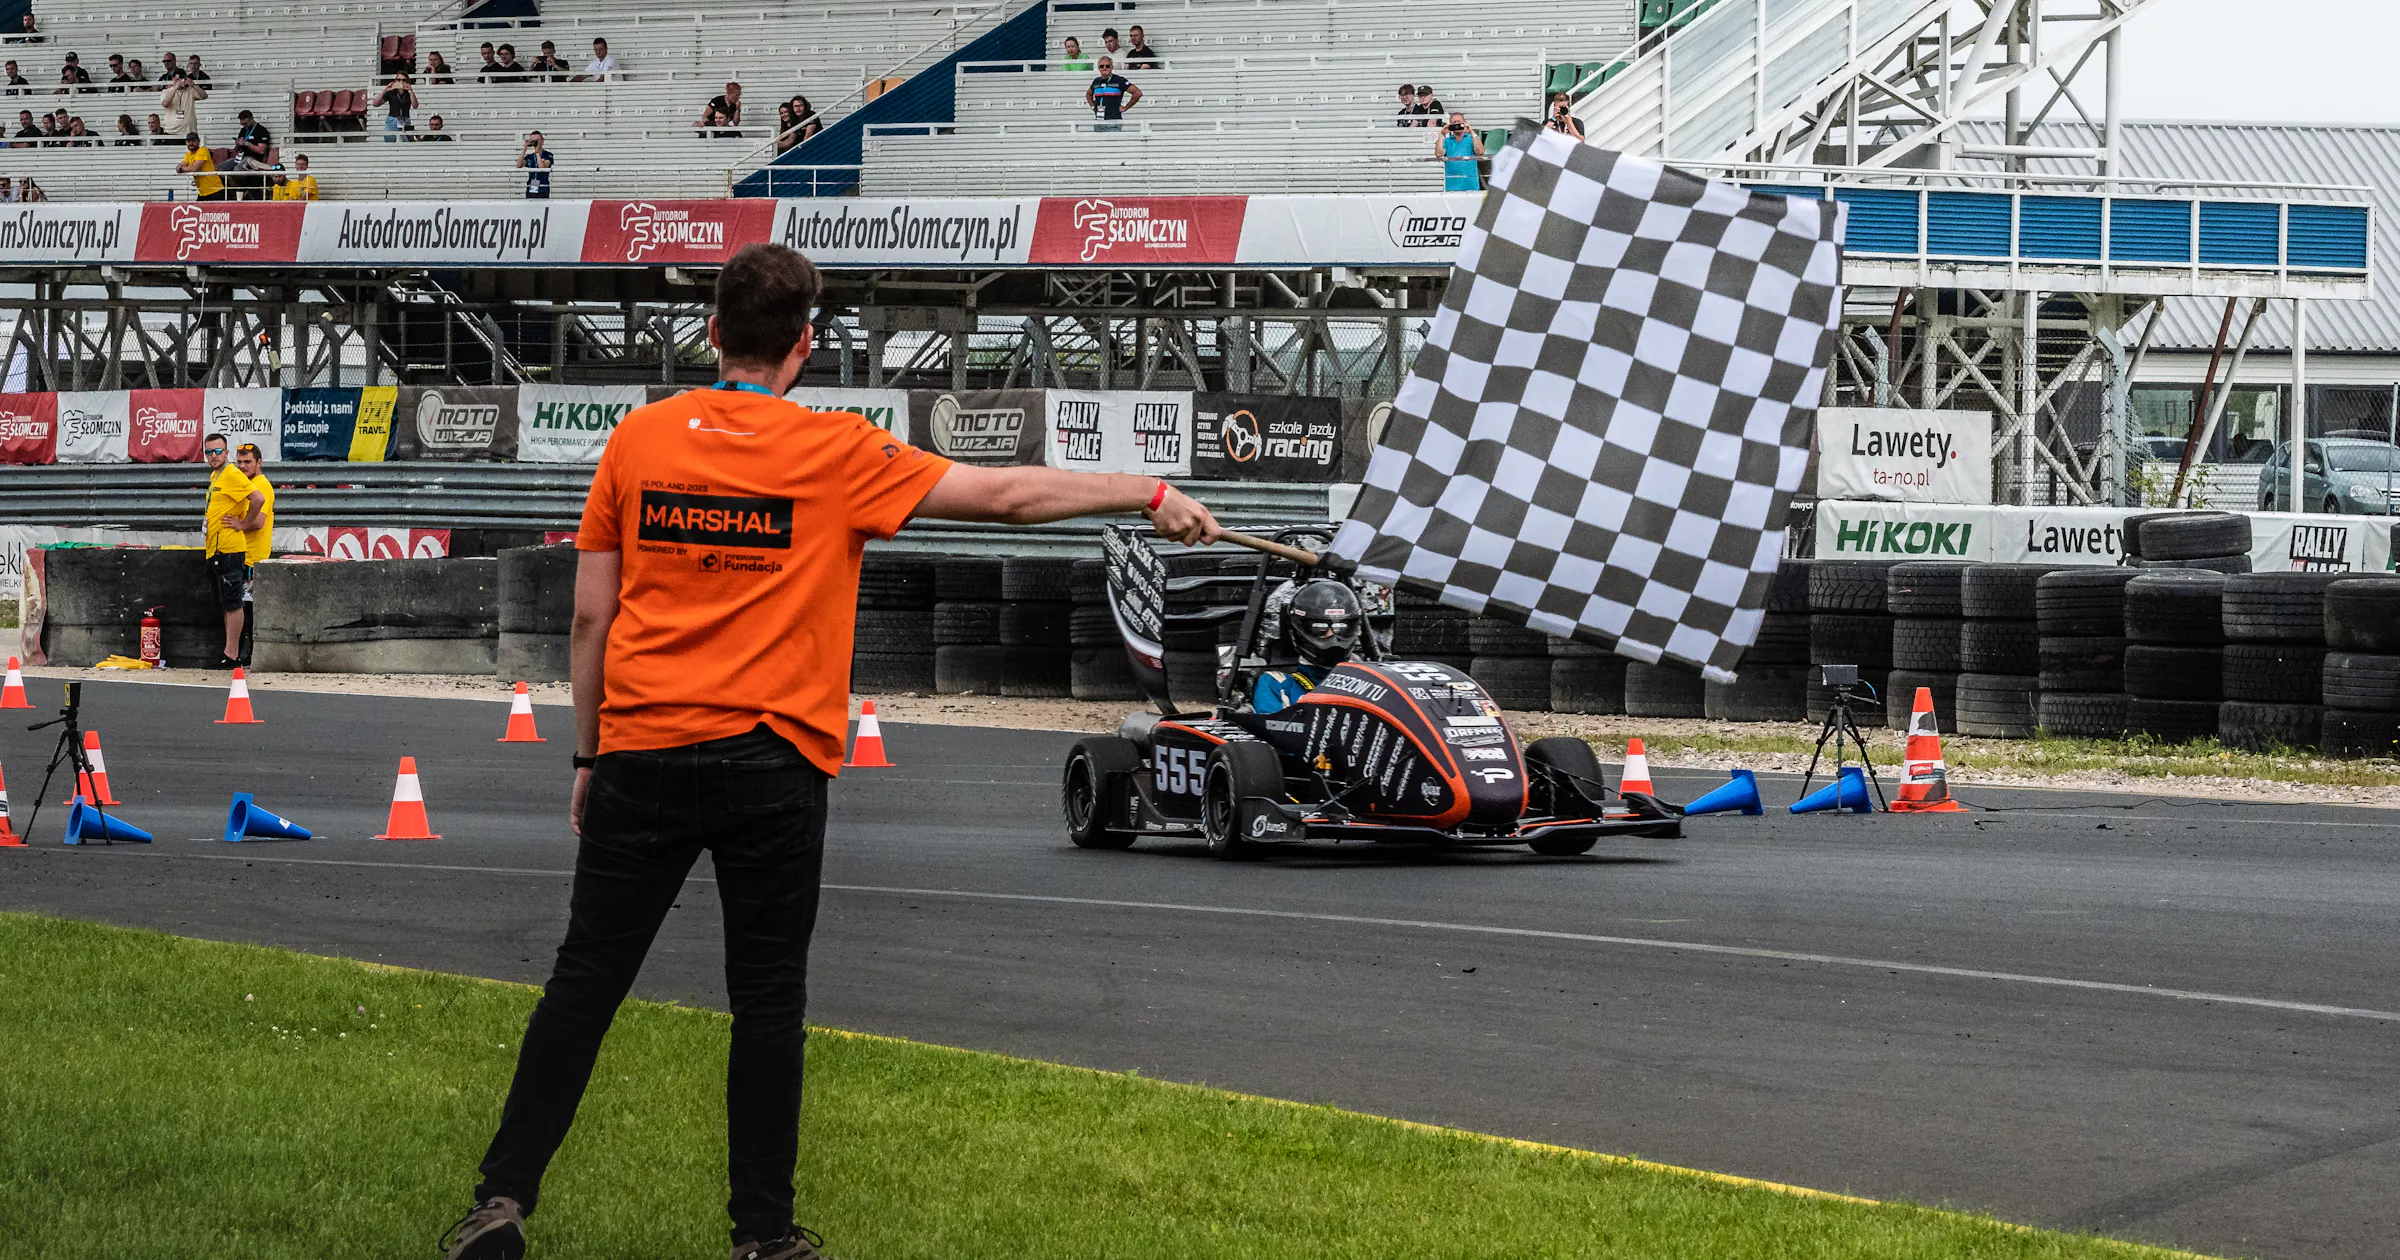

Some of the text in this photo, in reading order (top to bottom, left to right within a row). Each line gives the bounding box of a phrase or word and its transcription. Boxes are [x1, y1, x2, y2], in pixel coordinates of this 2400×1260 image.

[199, 213, 230, 223] AUTODROM
[653, 211, 689, 221] AUTODROM
[1110, 208, 1150, 219] AUTODROM
[338, 206, 549, 259] AutodromSlomczyn.pl
[652, 221, 723, 244] SŁOMCZYN
[784, 205, 1021, 260] AutodromSlomczyn.pl
[1108, 219, 1187, 244] SŁOMCZYN
[1406, 216, 1467, 232] MOTO
[198, 223, 260, 245] SŁOMCZYN
[1403, 235, 1462, 247] WIZJA
[285, 400, 323, 417] Podróżuj
[324, 404, 329, 414] z
[330, 401, 353, 414] nami
[436, 407, 498, 426] MOTO
[1059, 402, 1099, 429] RALLY
[155, 419, 198, 434] SŁOMCZYN
[231, 418, 272, 432] SŁOMCZYN
[954, 412, 1023, 432] MOTO
[1137, 405, 1178, 431] RALLY
[9, 422, 48, 436] SŁOMCZYN
[81, 421, 122, 435] SŁOMCZYN
[284, 420, 330, 436] po Europie
[358, 426, 387, 434] TRAVEL
[434, 429, 492, 442] WIZJA
[1269, 422, 1337, 438] szkoła jazdy
[530, 436, 546, 445] HIGH
[547, 437, 587, 446] PERFORMANCE
[952, 438, 1015, 450] WIZJA
[1067, 434, 1100, 460] RACE
[1145, 435, 1178, 461] RACE
[1851, 423, 1957, 468] Lawety.
[1265, 436, 1333, 465] racing
[650, 480, 685, 491] POLAND
[687, 484, 708, 492] 2023
[1873, 468, 1930, 489] ta-no.pl
[645, 503, 781, 534] MARSHAL
[637, 544, 688, 556] POWERED BY
[2292, 526, 2346, 559] RALLY
[724, 560, 783, 574] Fundacja
[1365, 683, 1388, 702] TU
[1154, 744, 1207, 797] 555
